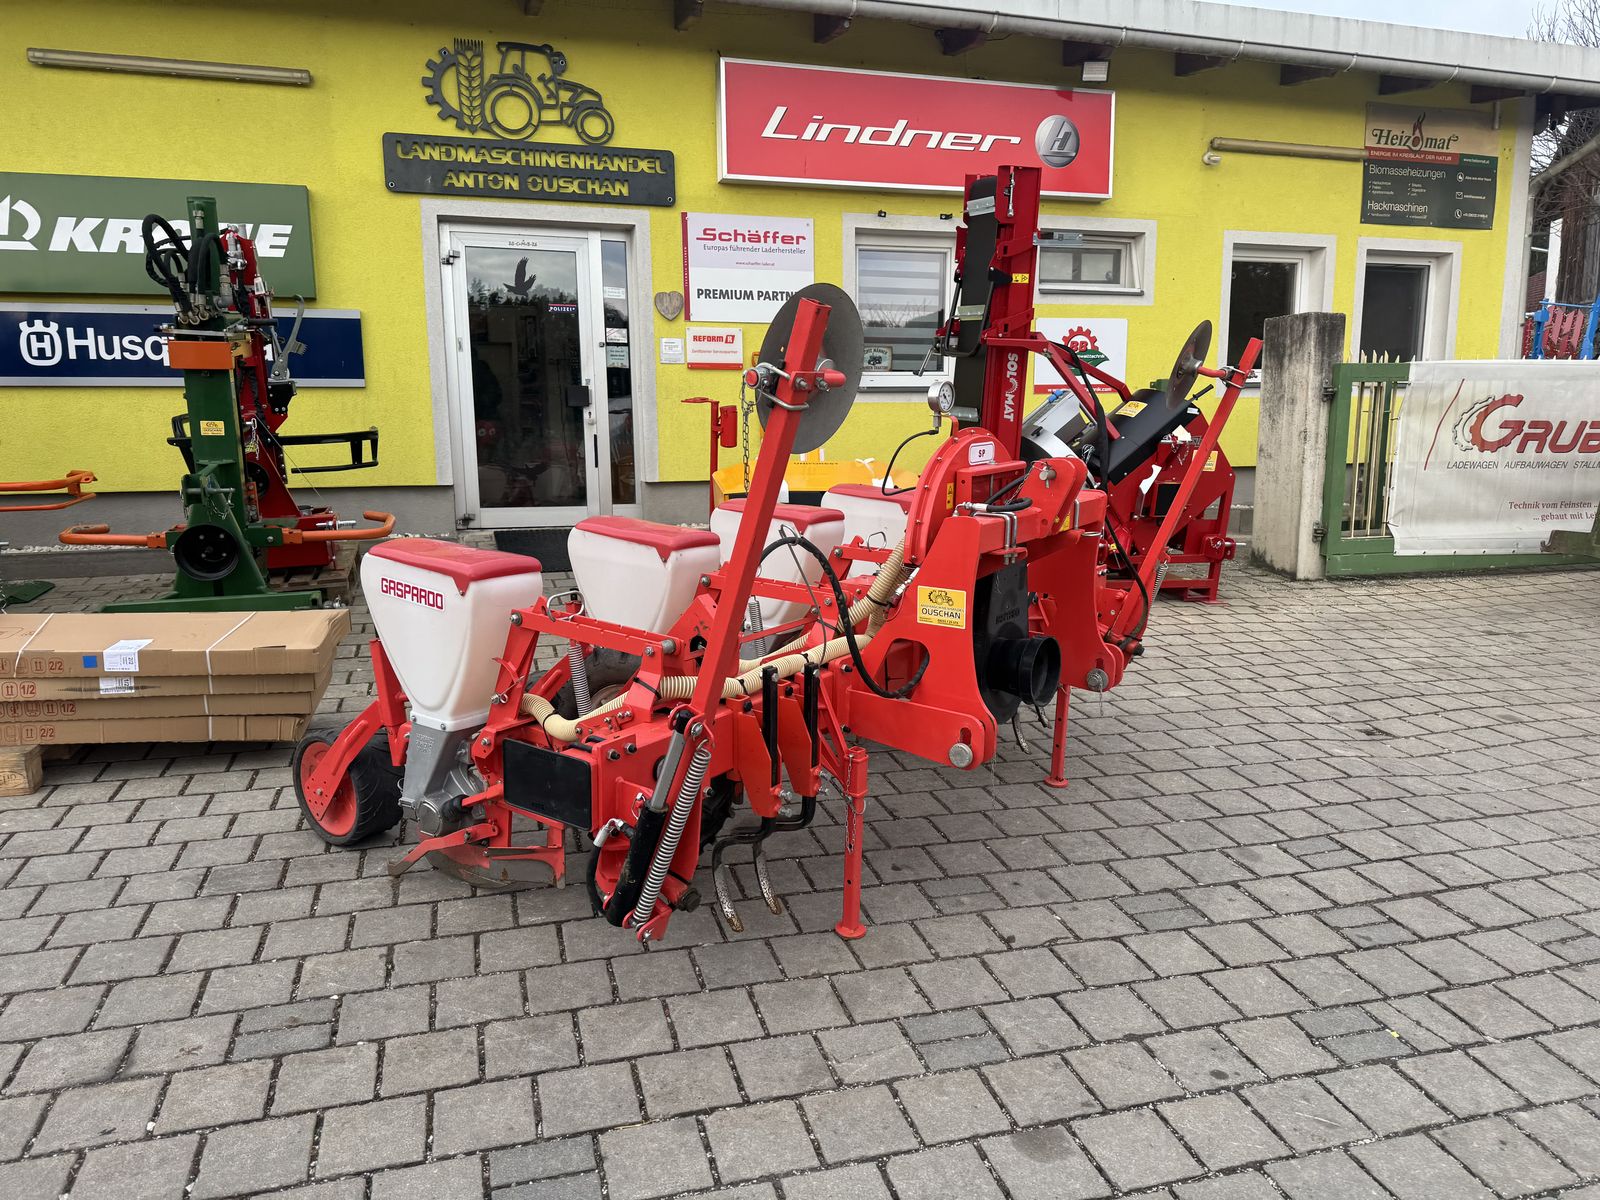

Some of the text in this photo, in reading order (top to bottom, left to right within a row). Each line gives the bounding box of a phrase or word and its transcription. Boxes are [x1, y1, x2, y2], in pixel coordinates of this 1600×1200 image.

[761, 106, 1021, 153] Lindner
[396, 141, 667, 174] LANDMASCHINENHANDEL
[1369, 164, 1446, 180] Biomasseheizungen
[442, 170, 629, 197] ANTON OUSCHAN
[1367, 200, 1428, 213] Hackmaschinen
[48, 216, 293, 258] KROE
[696, 228, 806, 245] Schäffer
[703, 244, 806, 255] Europas führender Laderhersteller
[697, 288, 797, 301] PREMIUM PARTN
[1447, 461, 1498, 469] LADEWAGEN
[1504, 461, 1568, 469] AUFBAUWAGEN
[1509, 501, 1540, 509] Technik
[1559, 500, 1592, 509] Feinsten
[1570, 511, 1583, 520] mit
[380, 577, 444, 610] GASPARDO
[921, 607, 961, 619] OUSCHAN
[48, 660, 63, 671] 2/2
[20, 684, 35, 694] 1/2
[61, 703, 76, 713] 1/2
[40, 728, 54, 738] 2/2
